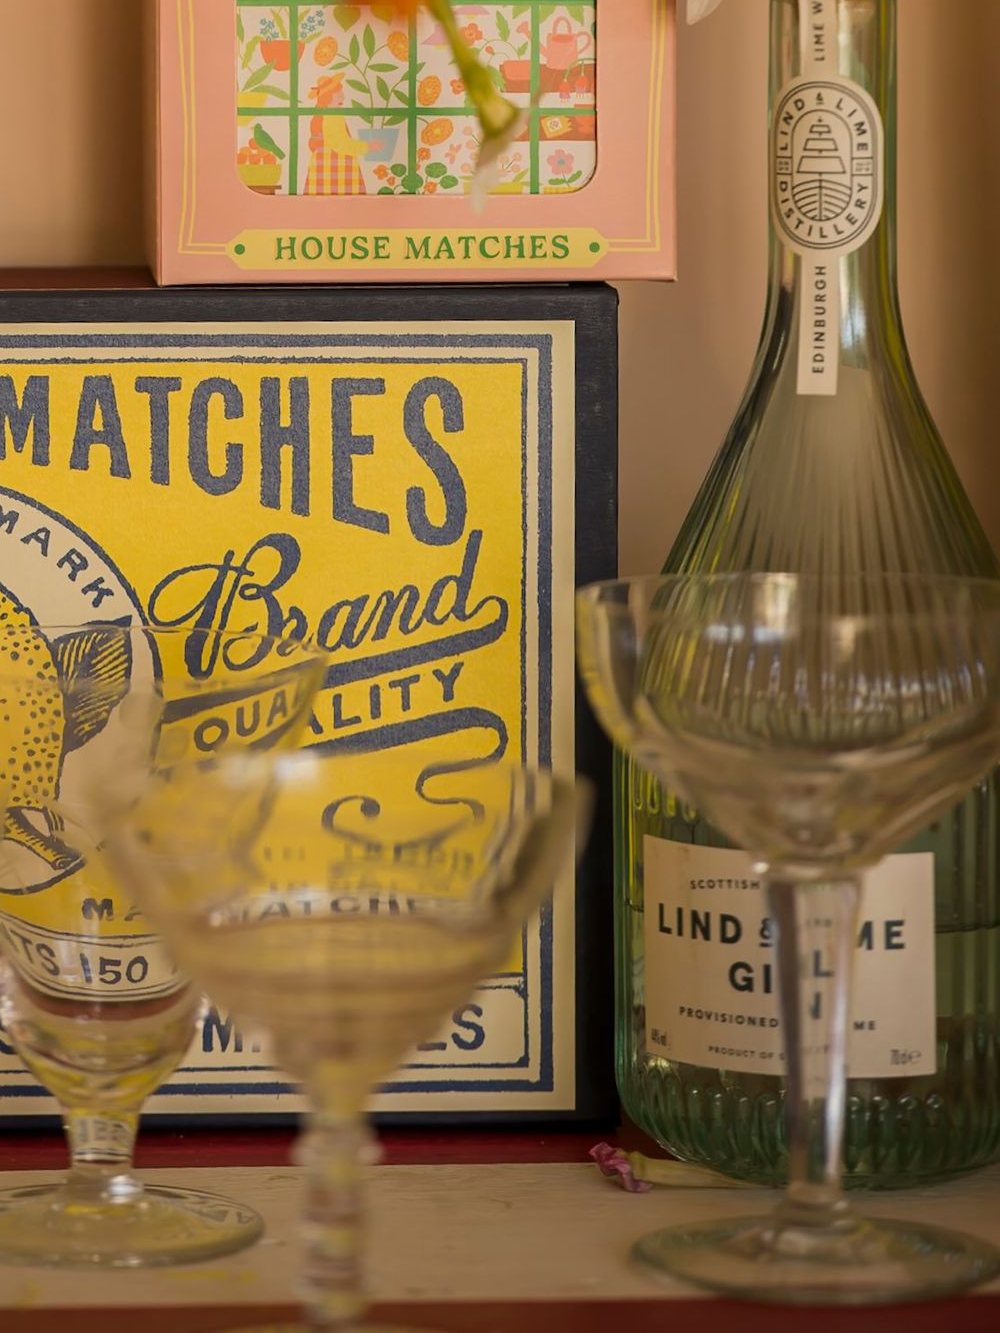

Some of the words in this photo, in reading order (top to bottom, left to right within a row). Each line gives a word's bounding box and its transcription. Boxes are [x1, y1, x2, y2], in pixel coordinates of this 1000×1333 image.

[813, 23, 825, 62] LIME
[778, 98, 806, 152] LIND
[836, 97, 869, 152] LIME
[778, 180, 869, 239] DISTILLERY
[275, 235, 391, 261] HOUSE
[404, 233, 571, 261] MATCHES
[812, 265, 827, 374] EDINBURGH
[148, 528, 507, 680] Brand
[193, 662, 464, 753] QUALITY
[690, 878, 761, 891] SCOTTISH
[658, 902, 743, 945] LIND
[80, 952, 149, 985] 150
[728, 961, 773, 994] GI
[679, 1006, 779, 1029] PROVISIONED
[708, 1044, 755, 1059] PRODUCT
